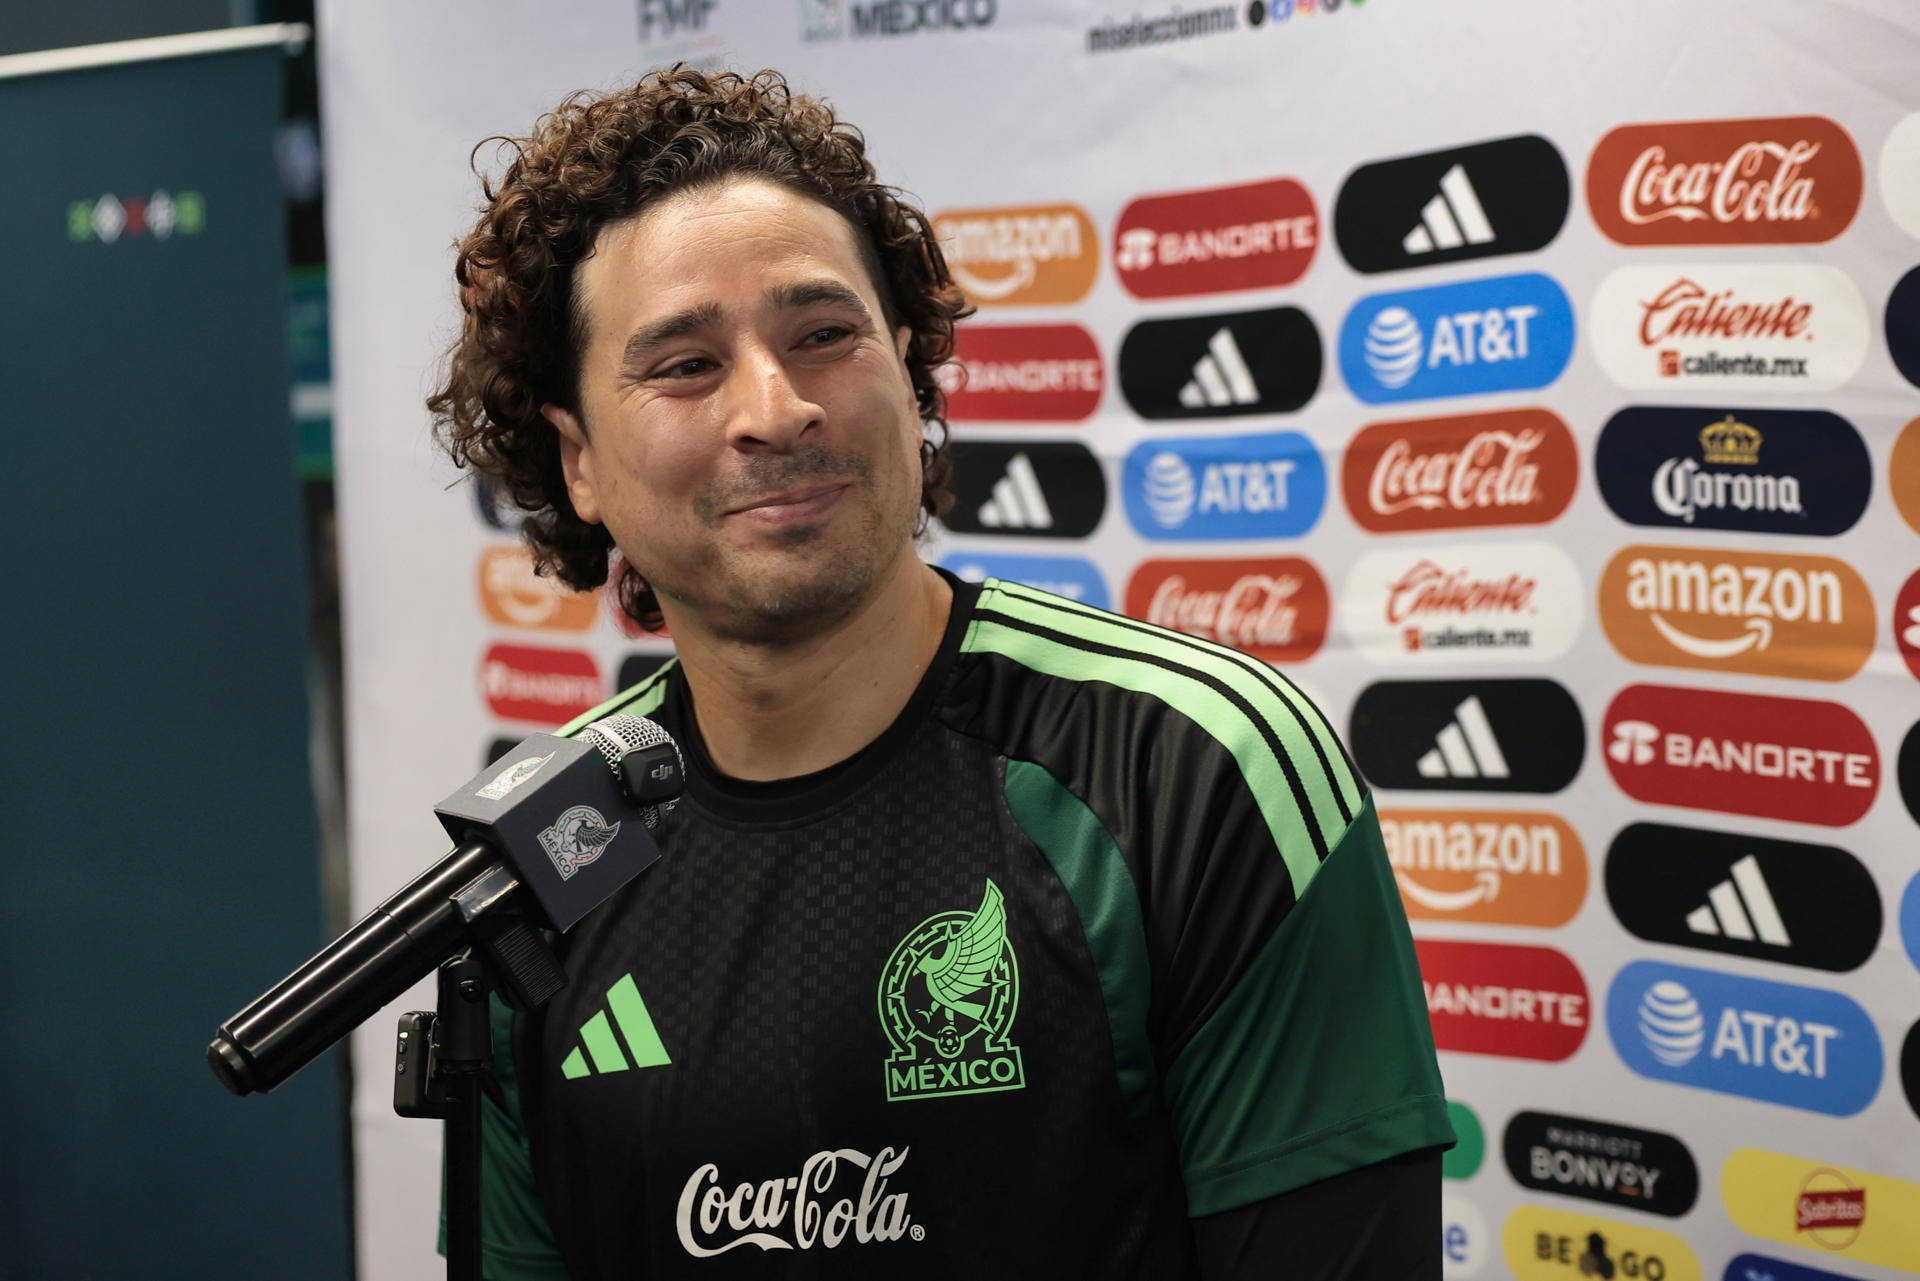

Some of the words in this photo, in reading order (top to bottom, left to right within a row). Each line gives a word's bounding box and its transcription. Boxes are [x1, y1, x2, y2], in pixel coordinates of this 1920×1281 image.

[1620, 140, 1821, 224] Coca-Cola
[937, 211, 1081, 262] amazon
[1158, 215, 1315, 264] BANORTE
[1428, 306, 1540, 369] AT&T
[965, 358, 1100, 393] BANORTE
[1683, 352, 1809, 377] caliente.mx
[1199, 460, 1298, 513] AT&T
[1652, 457, 1801, 522] Corona
[1627, 558, 1843, 623] amazon
[1665, 733, 1872, 788] BANORTE
[1380, 820, 1562, 876] amazon
[1712, 1007, 1843, 1078] AT&T
[890, 1057, 1016, 1093] MÉXICO
[1545, 1127, 1643, 1159] MARRIOTT
[1529, 1146, 1662, 1199] BONVOY
[1534, 1232, 1572, 1264] BE
[1621, 1252, 1665, 1281] GO
